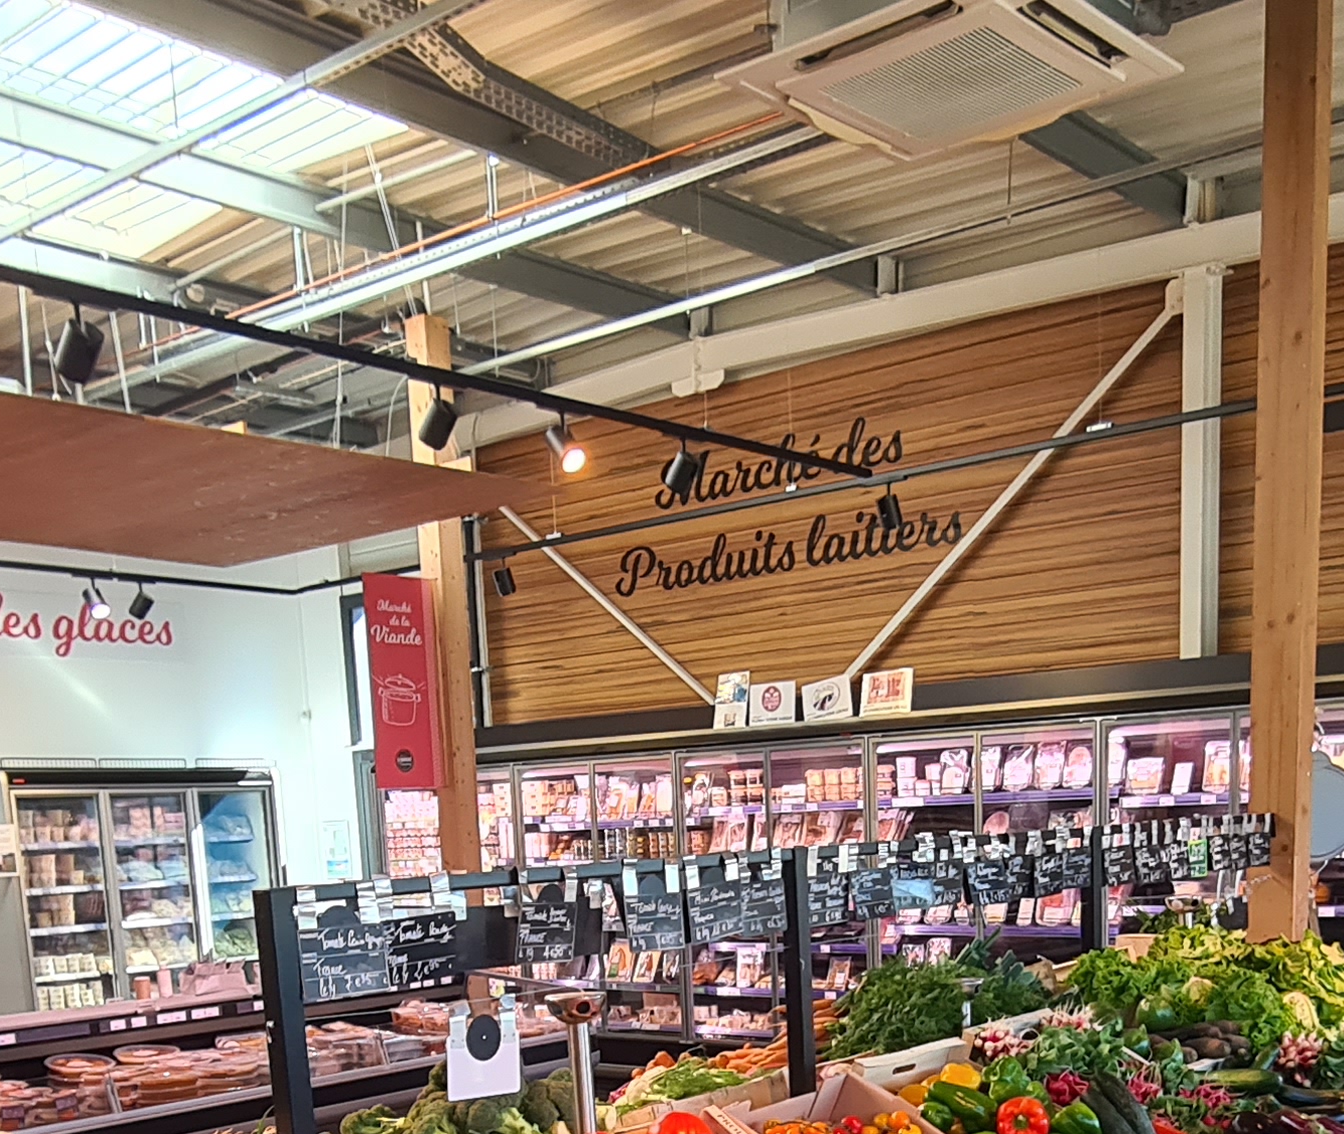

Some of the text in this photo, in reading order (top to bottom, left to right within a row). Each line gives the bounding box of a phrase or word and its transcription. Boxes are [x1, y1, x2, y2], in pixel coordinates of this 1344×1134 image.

[655, 417, 902, 509] Marché des
[615, 511, 962, 597] Produits laitiers
[377, 599, 412, 613] Marché
[389, 616, 410, 627] de la
[53, 604, 173, 657] glaces
[370, 625, 422, 645] Viande
